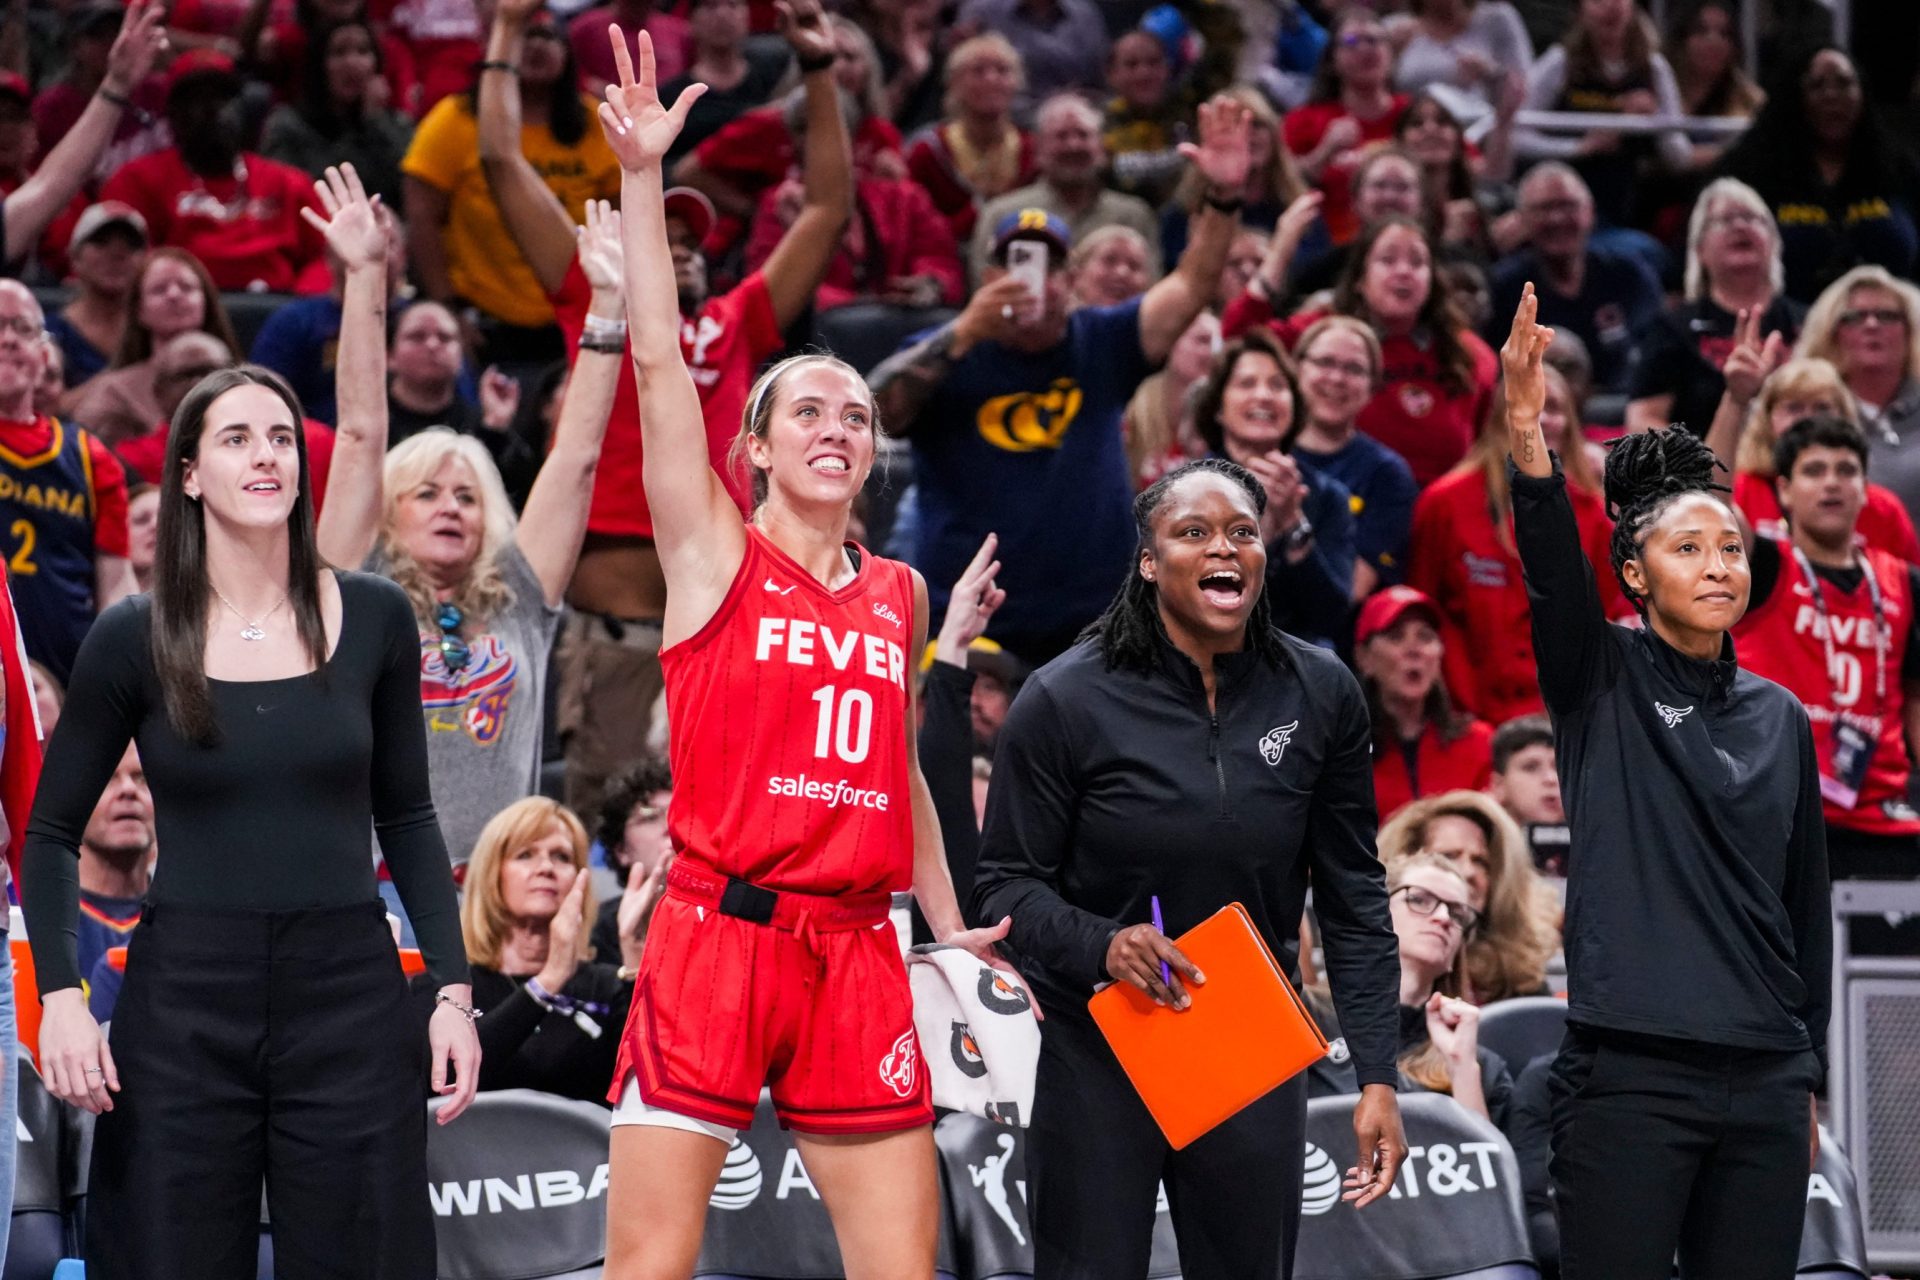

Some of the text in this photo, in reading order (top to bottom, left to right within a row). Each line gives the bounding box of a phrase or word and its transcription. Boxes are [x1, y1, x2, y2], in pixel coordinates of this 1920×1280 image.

[10, 519, 38, 576] 2
[872, 602, 902, 629] Lilly
[755, 617, 905, 692] FEVER
[811, 684, 874, 764] 10
[767, 773, 889, 811] salesforce
[1374, 1143, 1500, 1199] T&T
